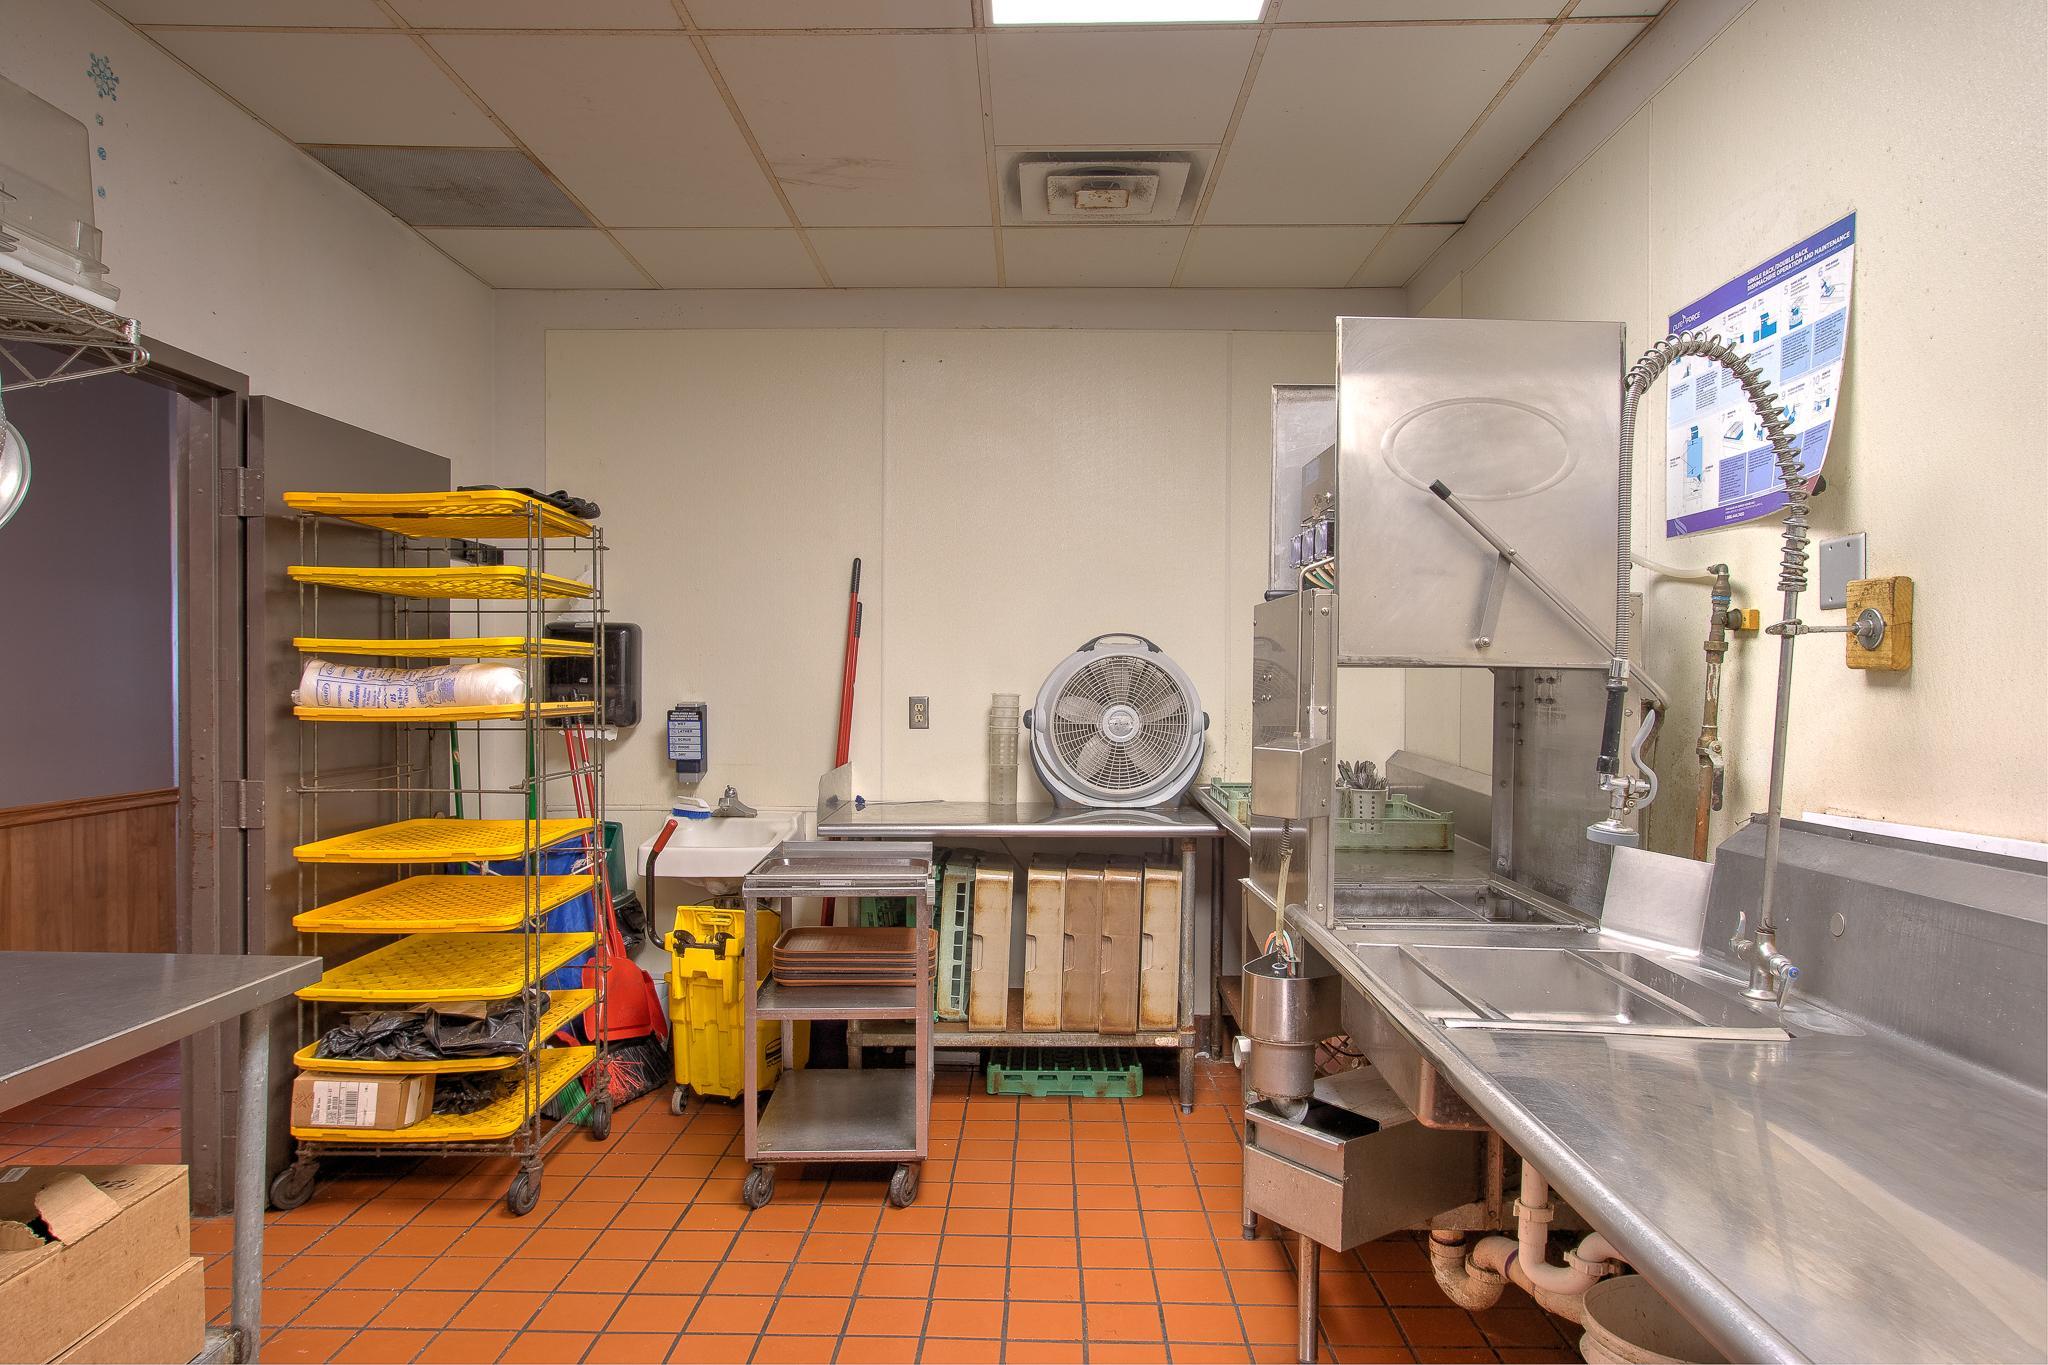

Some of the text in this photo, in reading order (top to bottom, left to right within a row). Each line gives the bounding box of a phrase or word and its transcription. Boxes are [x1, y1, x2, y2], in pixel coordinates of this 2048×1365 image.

[1747, 273, 1763, 285] SINGLE
[1795, 247, 1808, 262] RACK
[1776, 257, 1803, 276] OPERATION
[1803, 251, 1813, 263] AND
[1814, 230, 1850, 255] MAINTENANCE
